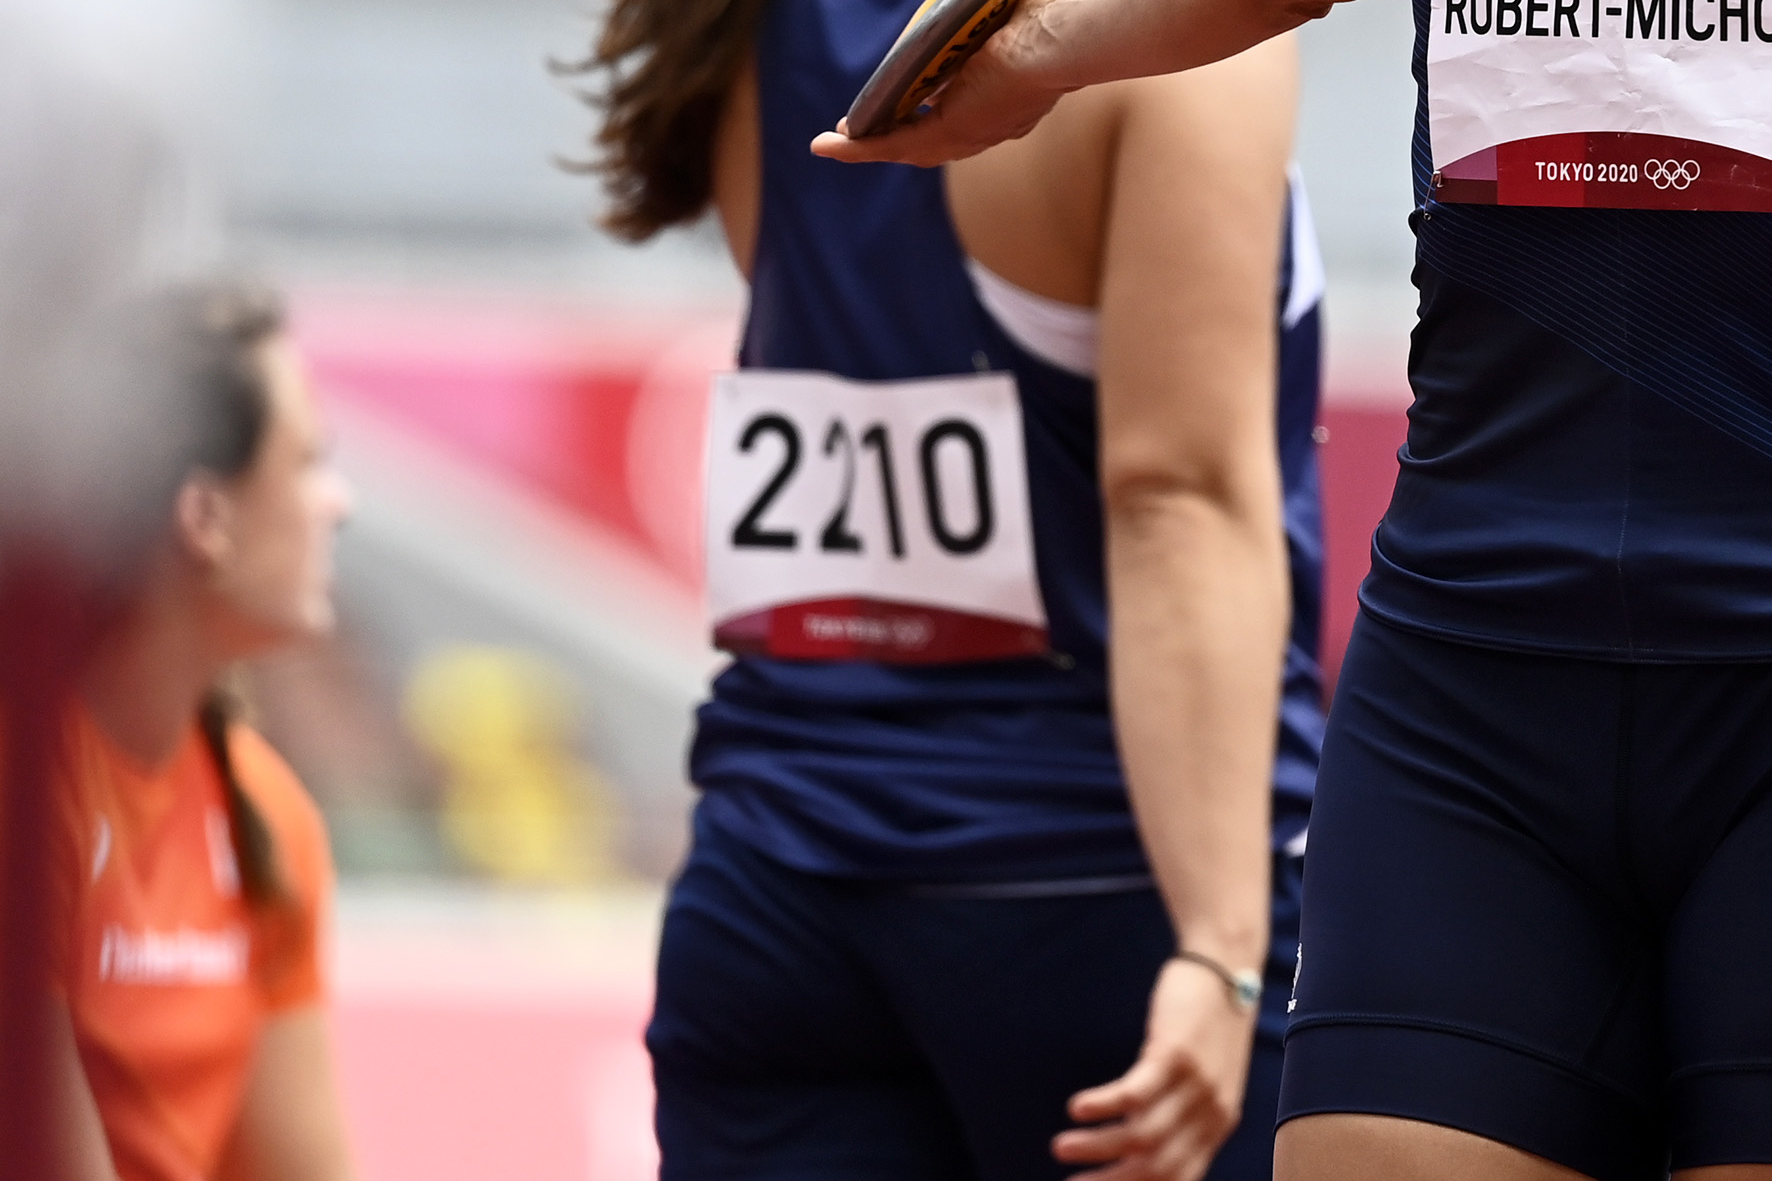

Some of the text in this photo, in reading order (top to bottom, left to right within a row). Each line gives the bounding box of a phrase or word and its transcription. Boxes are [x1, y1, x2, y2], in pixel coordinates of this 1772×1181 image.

[1535, 161, 1638, 183] TOKYO 2020
[731, 413, 994, 560] 2210
